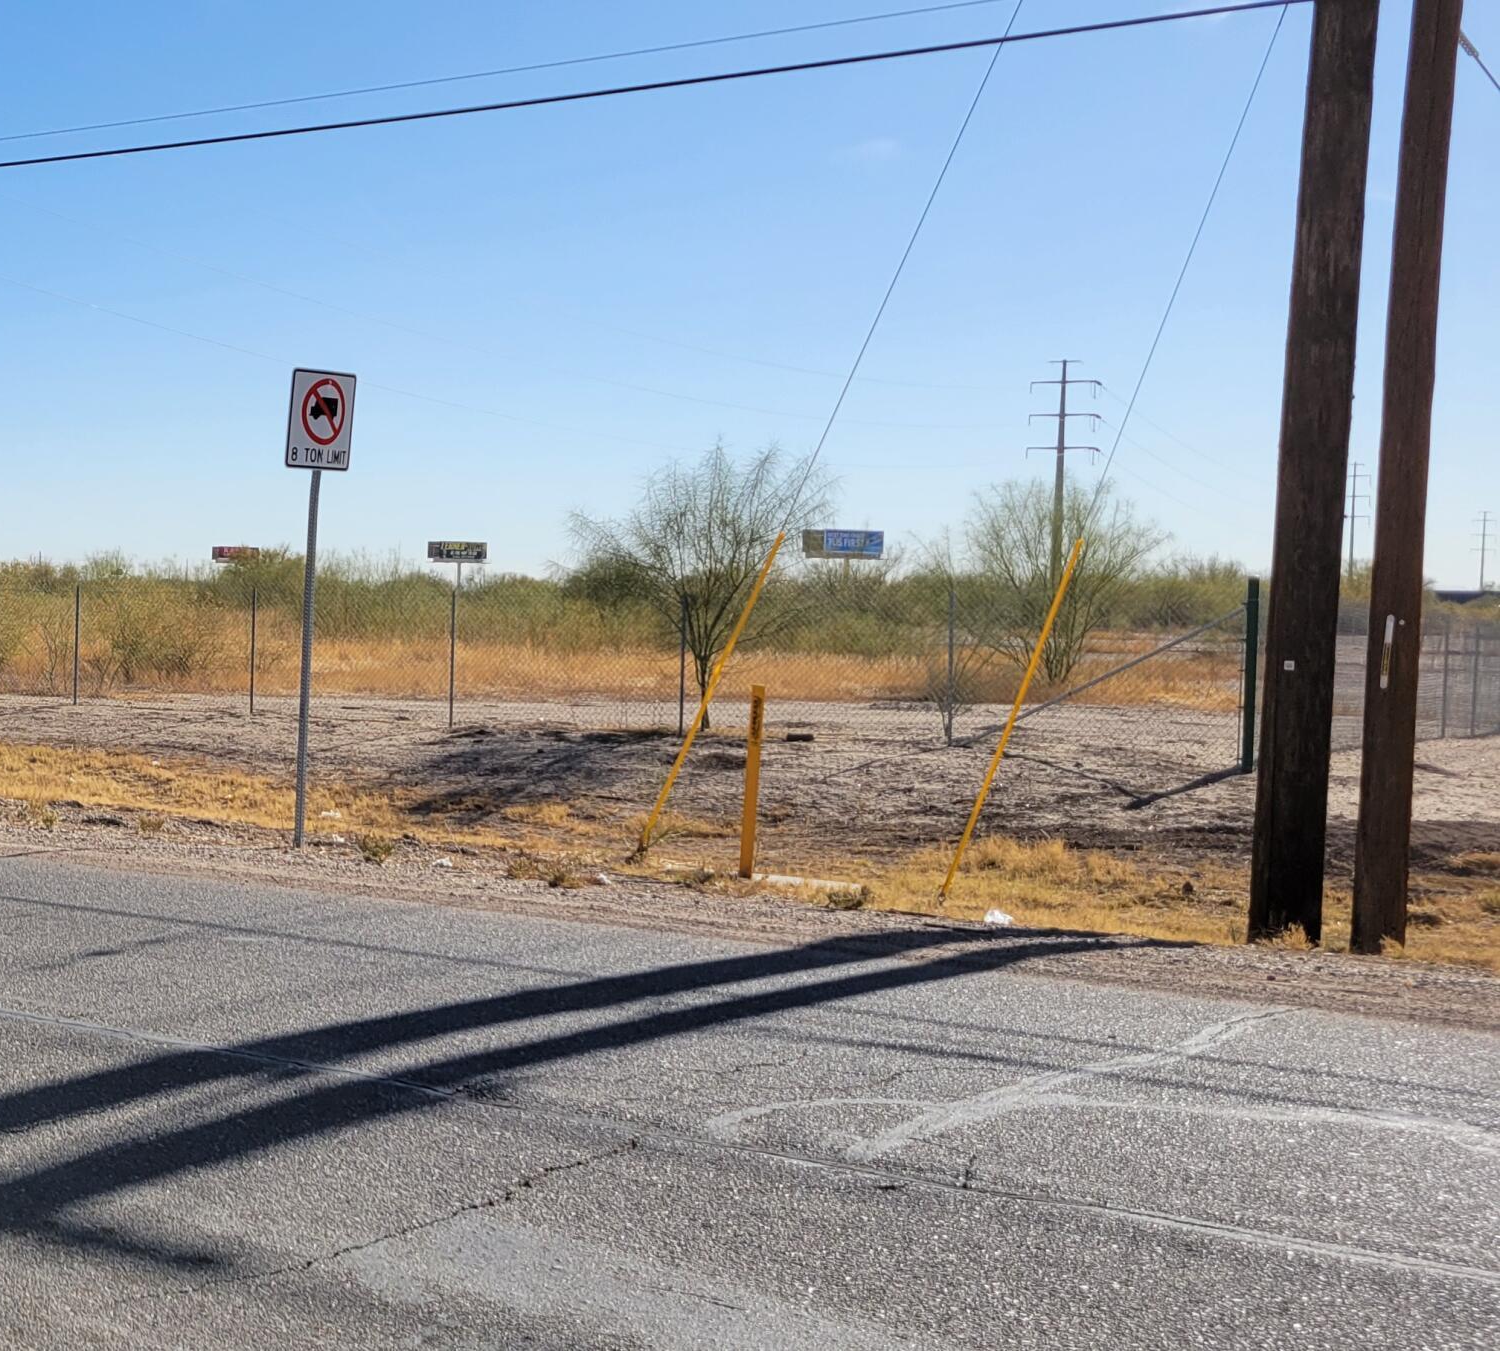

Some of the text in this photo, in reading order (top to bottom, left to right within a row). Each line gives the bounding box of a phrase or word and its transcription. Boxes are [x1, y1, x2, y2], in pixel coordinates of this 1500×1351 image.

[291, 446, 346, 465] 8 TON LIMIT
